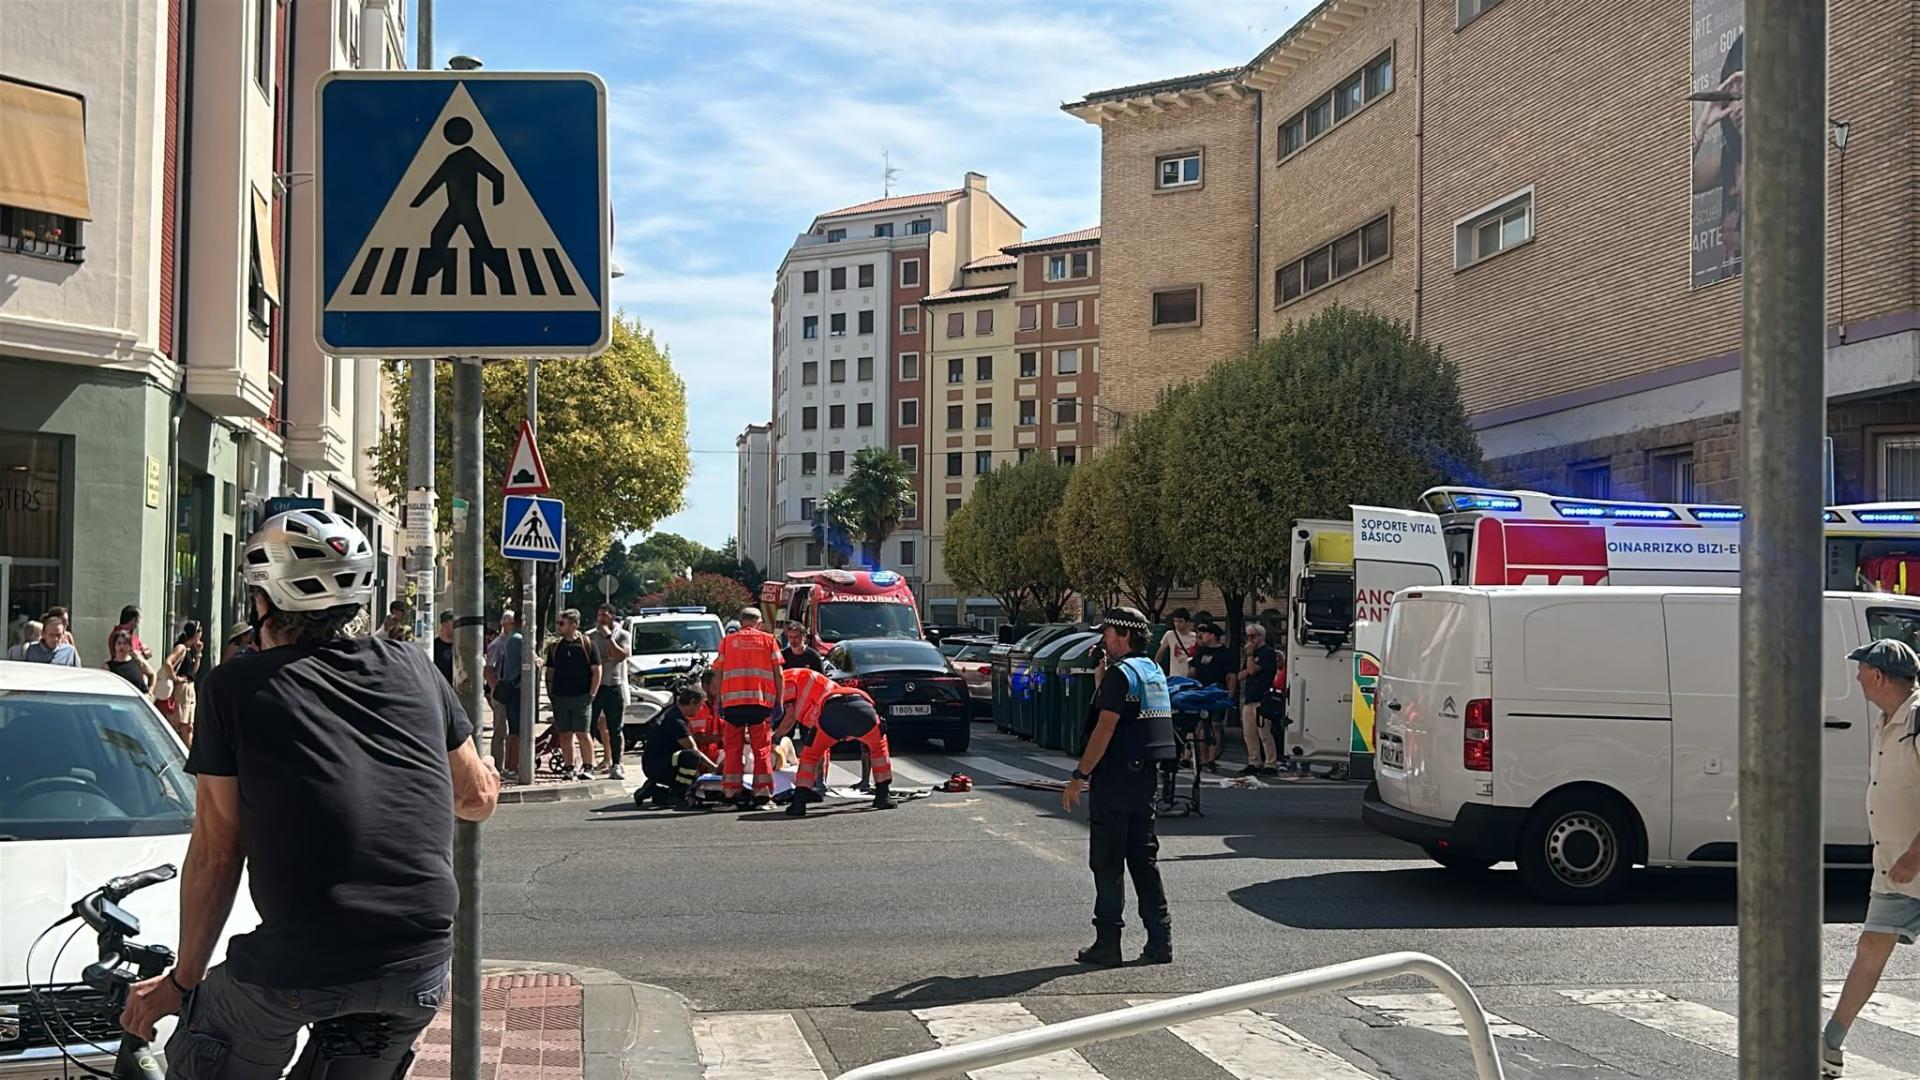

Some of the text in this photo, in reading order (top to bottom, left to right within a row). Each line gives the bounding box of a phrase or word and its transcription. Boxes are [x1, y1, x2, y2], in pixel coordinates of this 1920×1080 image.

[1693, 14, 1712, 41] RTE
[1693, 226, 1723, 252] ARTE
[1361, 519, 1437, 535] SOPORTE VITAL
[1608, 542, 1740, 554] OINARRIZKO BIZI-E
